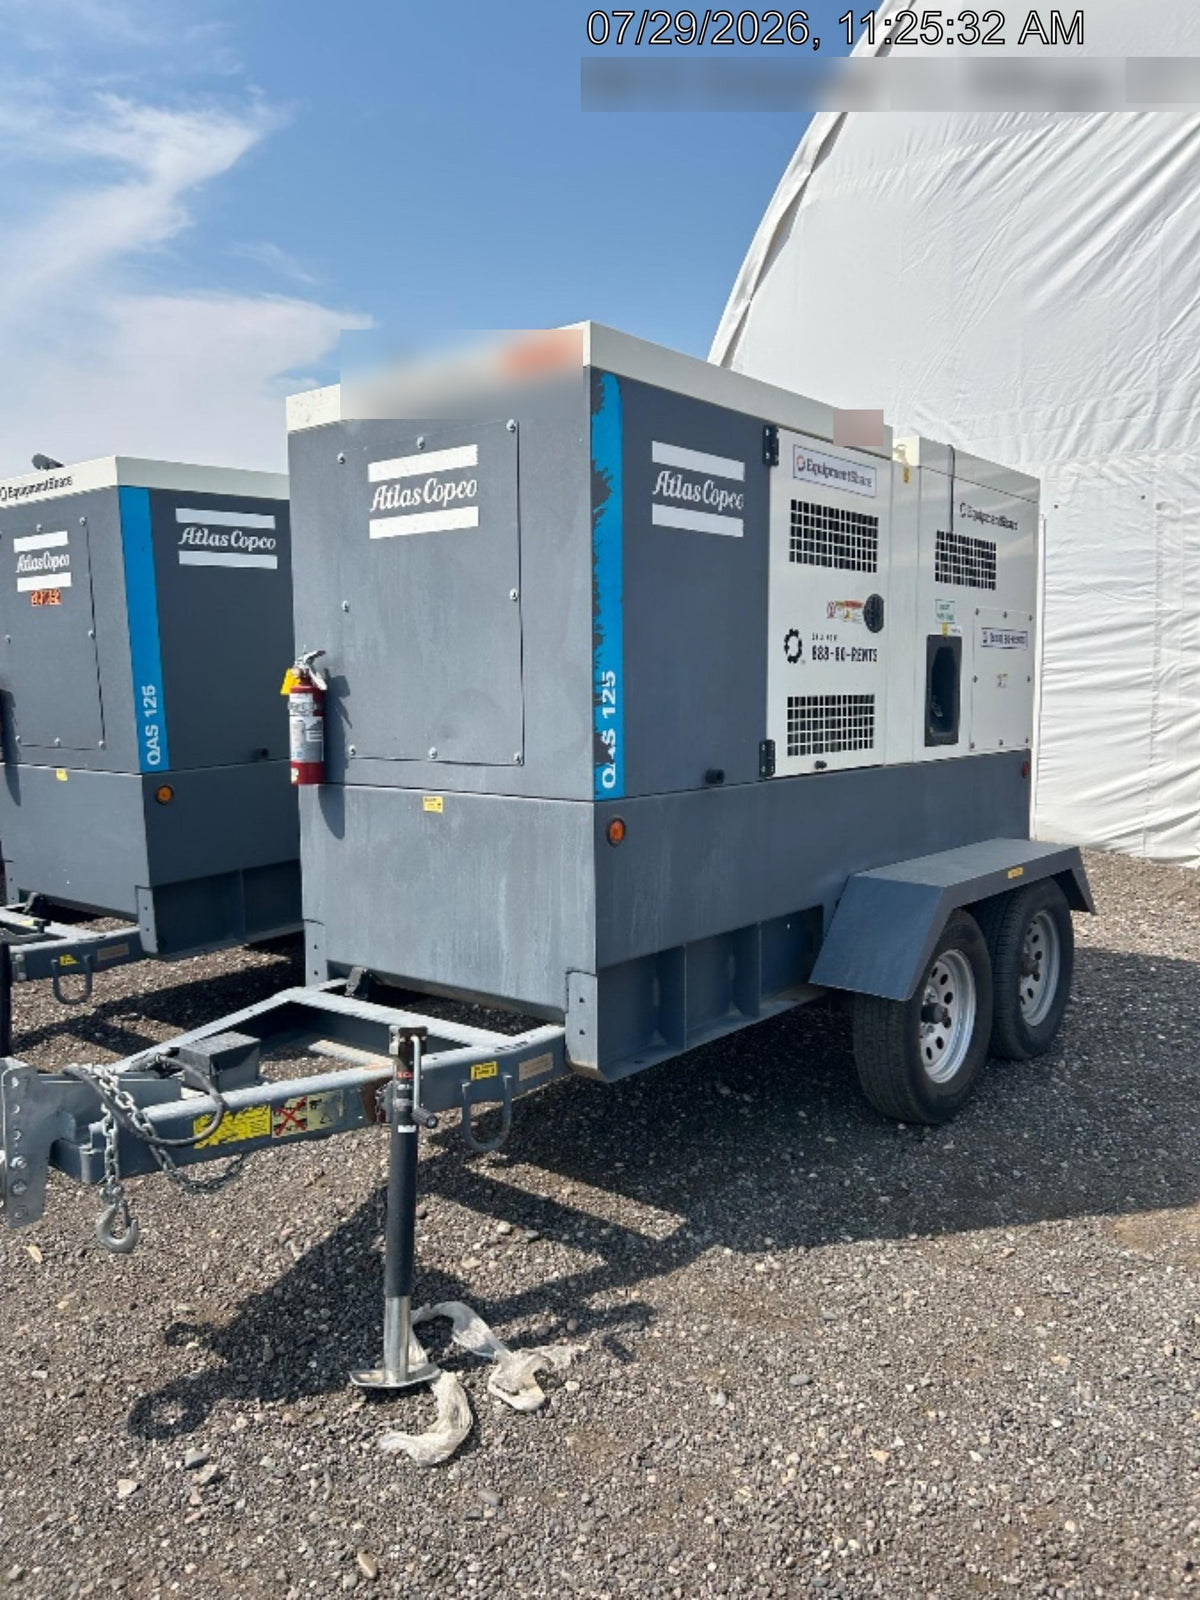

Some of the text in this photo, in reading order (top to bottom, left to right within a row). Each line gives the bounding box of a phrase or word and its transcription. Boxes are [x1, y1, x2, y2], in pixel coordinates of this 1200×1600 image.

[369, 477, 478, 513] Atlas Copco
[652, 470, 701, 502] Atlas
[178, 527, 276, 552] Atlas Copco
[601, 670, 617, 718] 125
[141, 684, 161, 766] QAS 125
